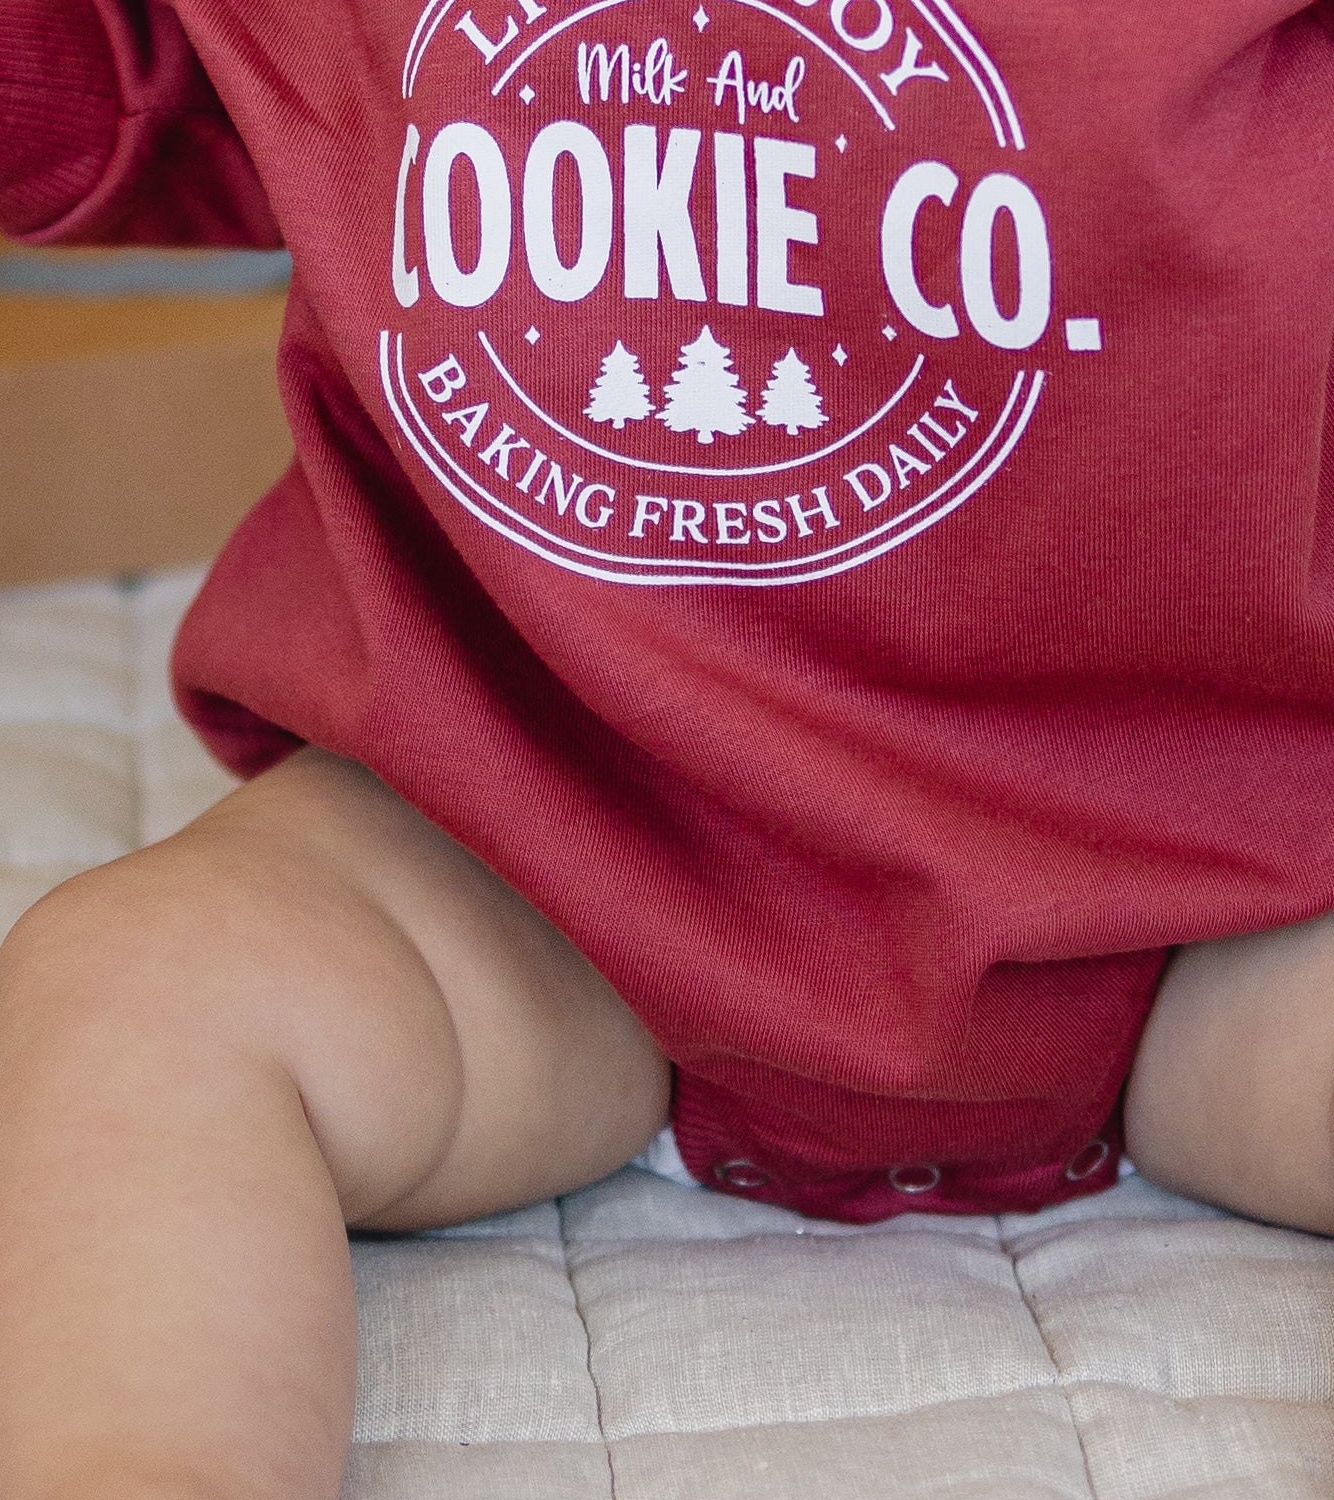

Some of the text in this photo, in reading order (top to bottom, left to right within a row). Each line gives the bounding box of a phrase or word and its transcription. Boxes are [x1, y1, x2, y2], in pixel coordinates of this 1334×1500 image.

[577, 37, 807, 125] Milk And
[881, 160, 1103, 352] CO.
[417, 353, 980, 545] BAKING FRESH DAILY
